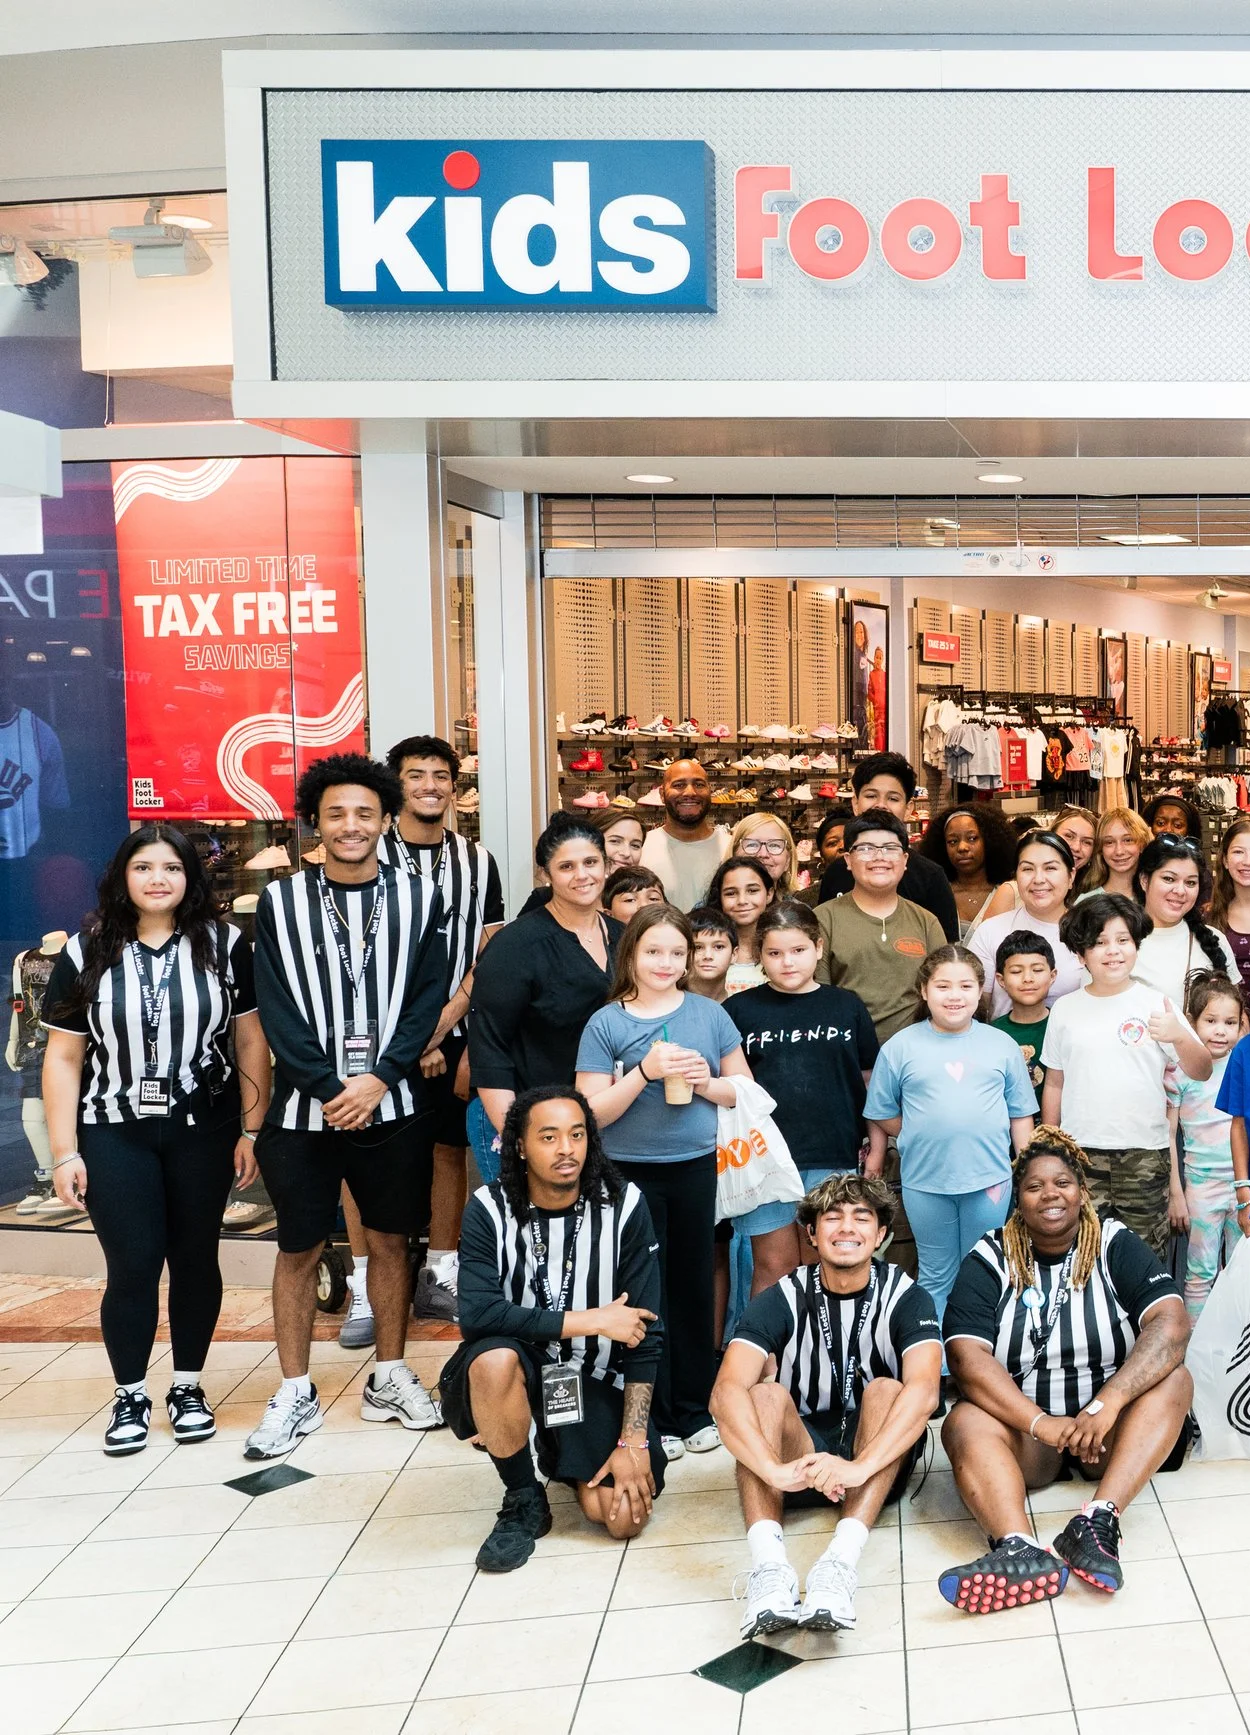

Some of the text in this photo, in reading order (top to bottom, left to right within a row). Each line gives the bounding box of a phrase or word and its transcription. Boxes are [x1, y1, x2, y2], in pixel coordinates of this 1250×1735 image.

[337, 150, 691, 295] kids
[151, 555, 317, 585] LIMITED TIME
[134, 589, 339, 638] TAX FREE
[134, 780, 152, 789] Kids
[135, 789, 152, 797] Foot
[135, 797, 162, 805] Locker
